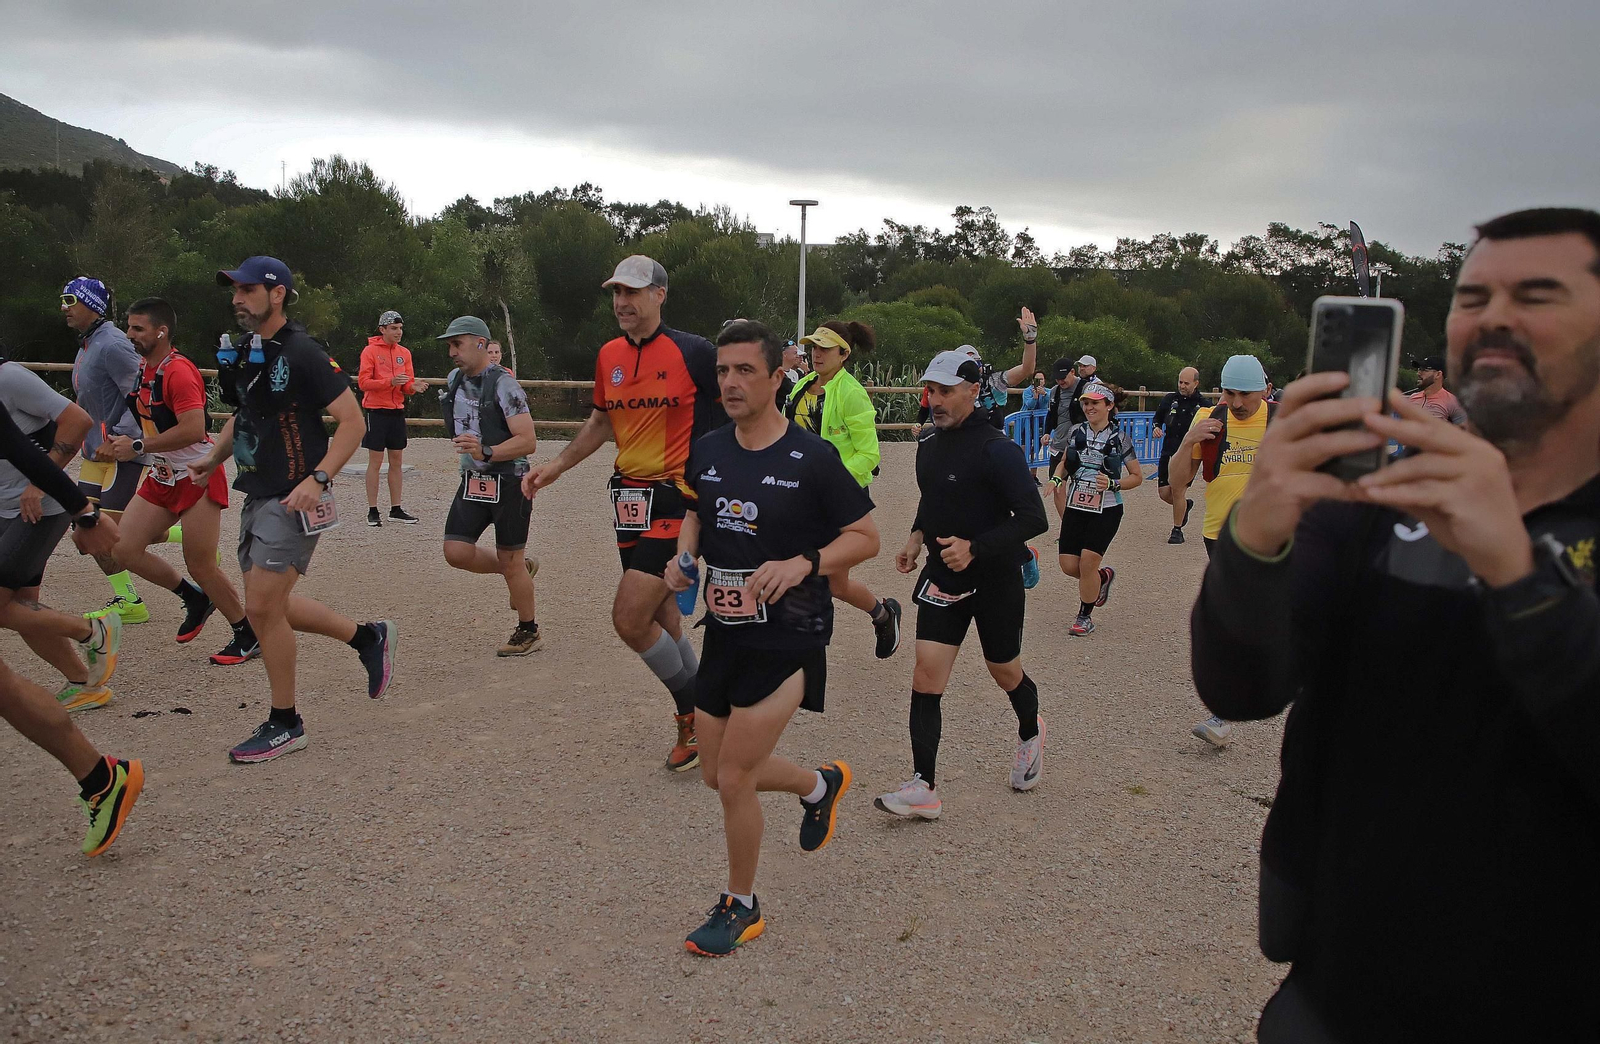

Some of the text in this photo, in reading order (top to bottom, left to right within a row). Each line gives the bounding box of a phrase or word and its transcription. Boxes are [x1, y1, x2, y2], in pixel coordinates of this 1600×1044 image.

[628, 397, 680, 410] CAMAS
[1223, 454, 1253, 463] WORLD
[480, 482, 487, 492] 6
[776, 479, 800, 489] mupol
[1078, 493, 1095, 503] 87
[623, 503, 639, 518] 15
[715, 496, 760, 522] 200
[716, 522, 757, 536] NACIONAL
[713, 588, 744, 608] 23
[268, 731, 291, 748] HOKA
